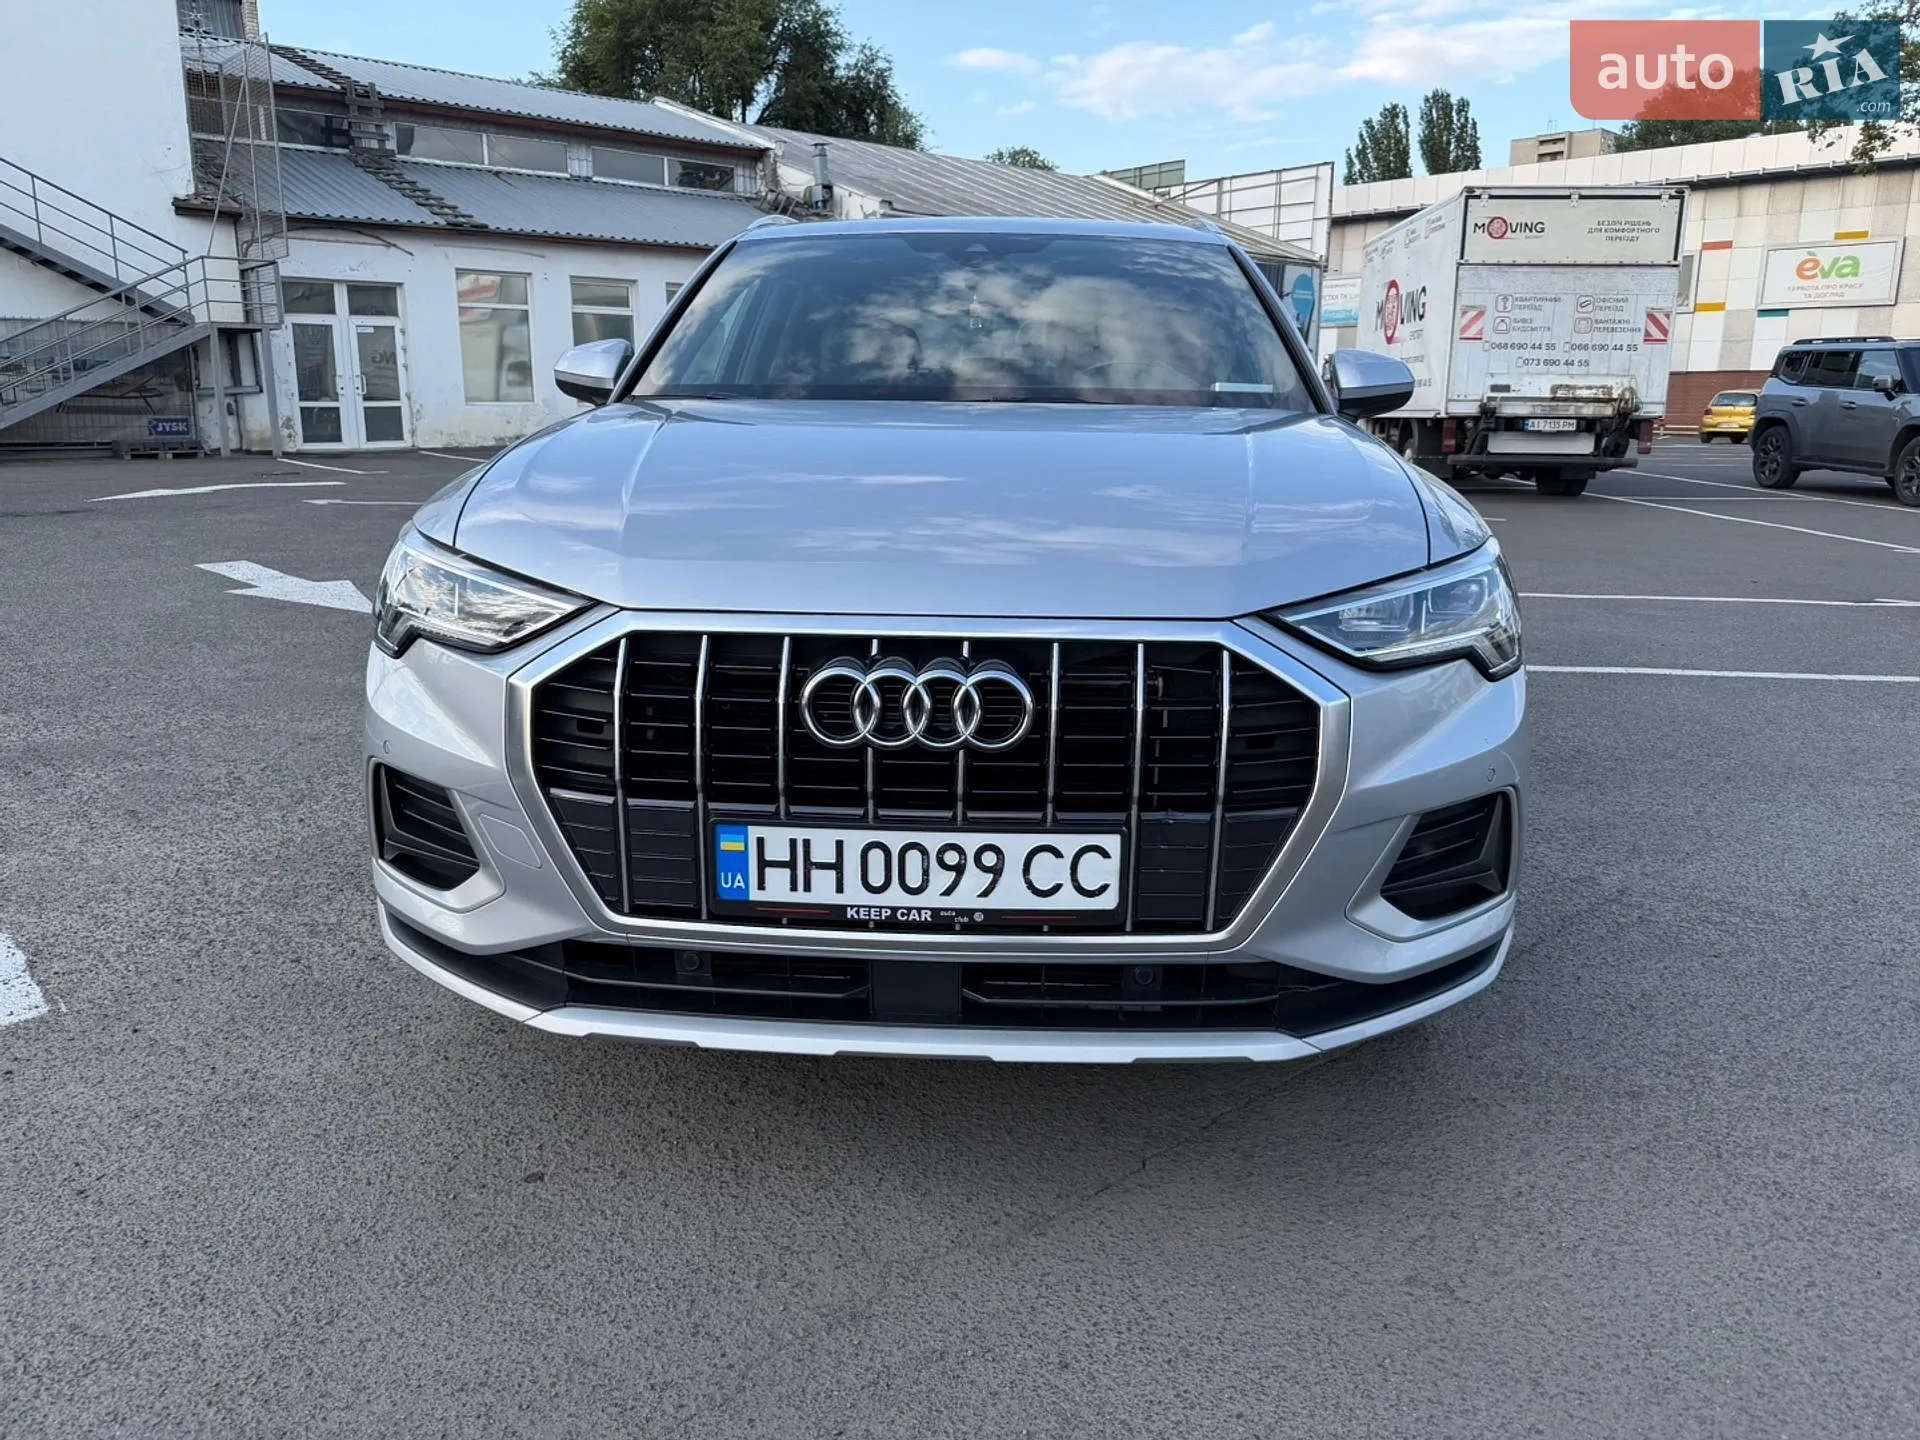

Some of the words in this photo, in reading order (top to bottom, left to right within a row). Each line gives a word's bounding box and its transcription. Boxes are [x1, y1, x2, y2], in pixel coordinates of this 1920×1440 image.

[1473, 216, 1545, 239] MOVING
[1491, 342, 1508, 350] 068
[1510, 342, 1528, 350] 690
[1545, 343, 1557, 351] 55
[1570, 343, 1589, 351] 066
[1591, 343, 1609, 351] 690
[1522, 358, 1540, 366] 073
[1542, 359, 1561, 367] 690
[1563, 359, 1575, 367] 44
[1577, 359, 1590, 367] 55
[156, 422, 188, 432] JYSK
[756, 836, 844, 894] HH
[860, 840, 1006, 898] 0099
[1022, 843, 1112, 898] CC
[721, 873, 745, 889] UA
[846, 906, 892, 920] KEEP
[896, 908, 933, 921] CAR
